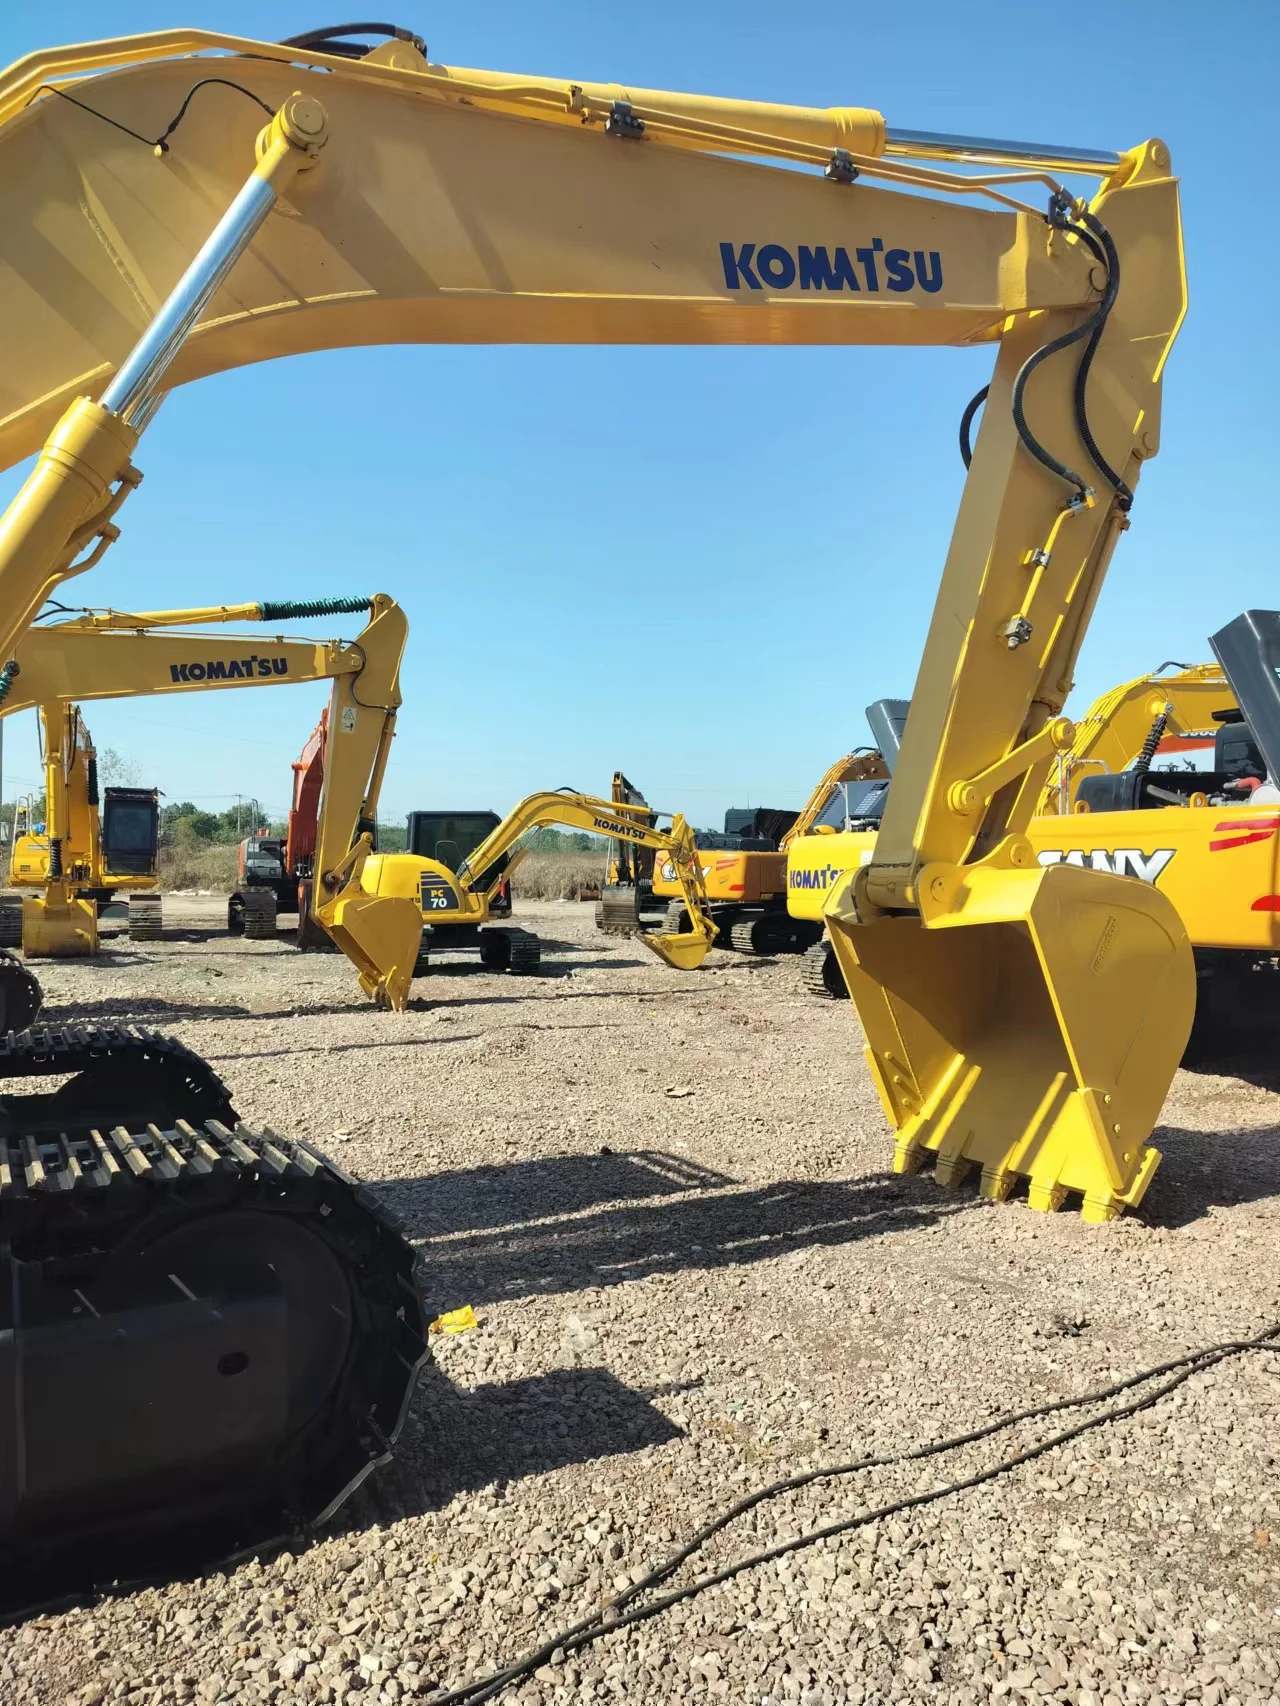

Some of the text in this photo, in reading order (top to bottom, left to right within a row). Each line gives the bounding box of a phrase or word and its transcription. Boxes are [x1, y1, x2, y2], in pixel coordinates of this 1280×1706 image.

[719, 237, 943, 293] KOMATSU
[170, 655, 288, 682] KOMATSU
[594, 818, 646, 839] KOMATSU
[430, 889, 444, 897] PC
[430, 897, 447, 908] 70
